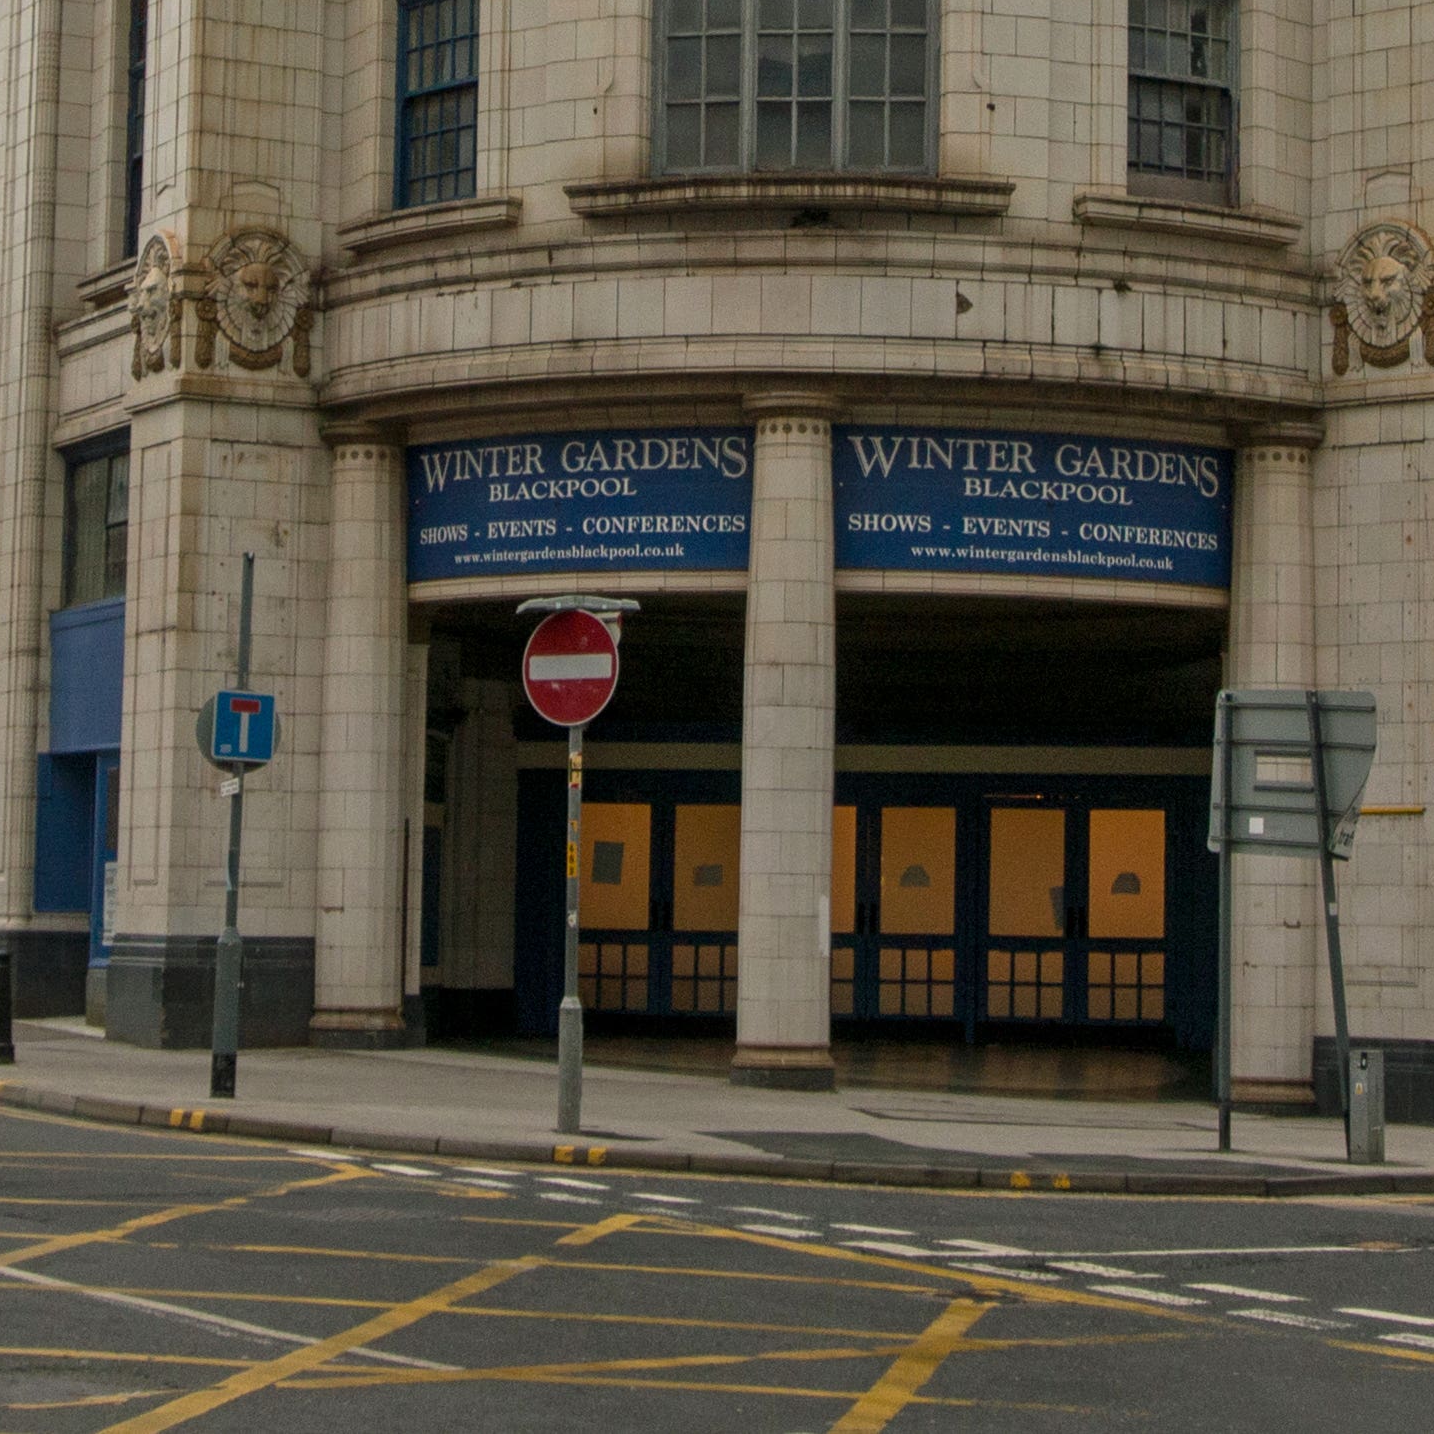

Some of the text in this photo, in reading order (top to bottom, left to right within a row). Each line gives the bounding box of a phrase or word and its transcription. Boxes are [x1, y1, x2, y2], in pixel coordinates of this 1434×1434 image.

[420, 436, 747, 493] WINTER GARDENS
[847, 435, 1218, 498] WINTER GARDENS
[489, 477, 637, 502] BLACKPOOL
[964, 477, 1133, 506] BLACKPOOL
[420, 524, 468, 545] SHOWS
[487, 518, 556, 539] EVENTS
[582, 514, 745, 534] CONFERENCES
[848, 513, 931, 533] SHOWS
[962, 517, 1050, 538] EVENTS
[1079, 523, 1218, 550] CONFERENCES
[454, 543, 684, 564] www.wintergardensblackpool.co.uk
[910, 544, 1173, 570] www.wintergardensblackpool.co.uk
